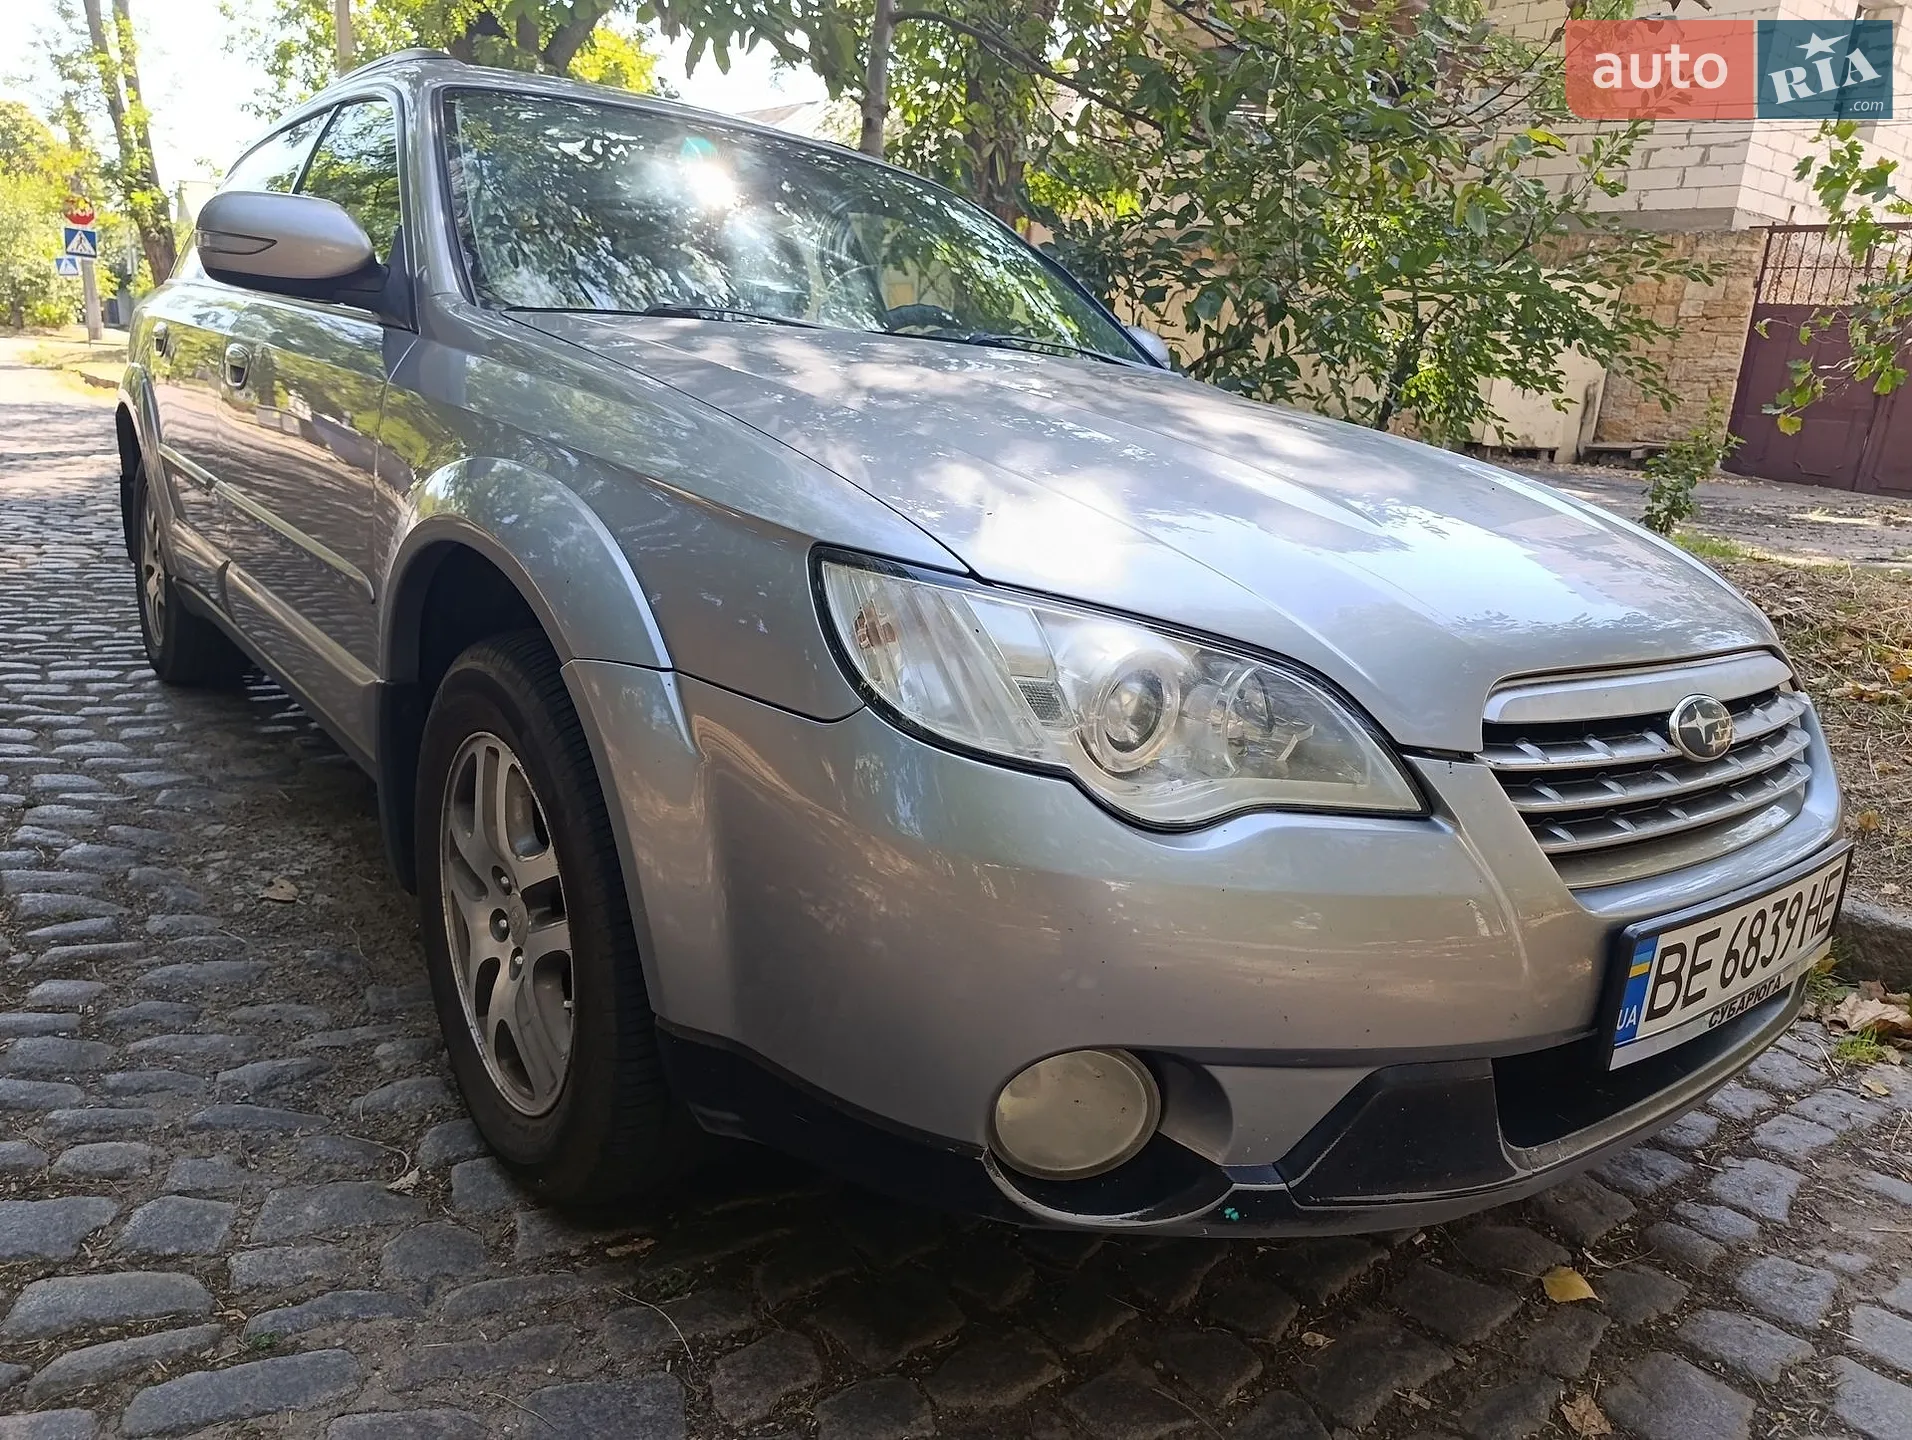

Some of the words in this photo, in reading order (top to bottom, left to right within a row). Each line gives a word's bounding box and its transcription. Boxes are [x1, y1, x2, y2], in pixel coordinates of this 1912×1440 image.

[1644, 927, 1722, 1022] BE
[1719, 891, 1804, 989] 6839
[1797, 866, 1842, 949] HE
[1616, 1004, 1638, 1031] UA
[1708, 975, 1782, 1028] СУБАРЮГА
